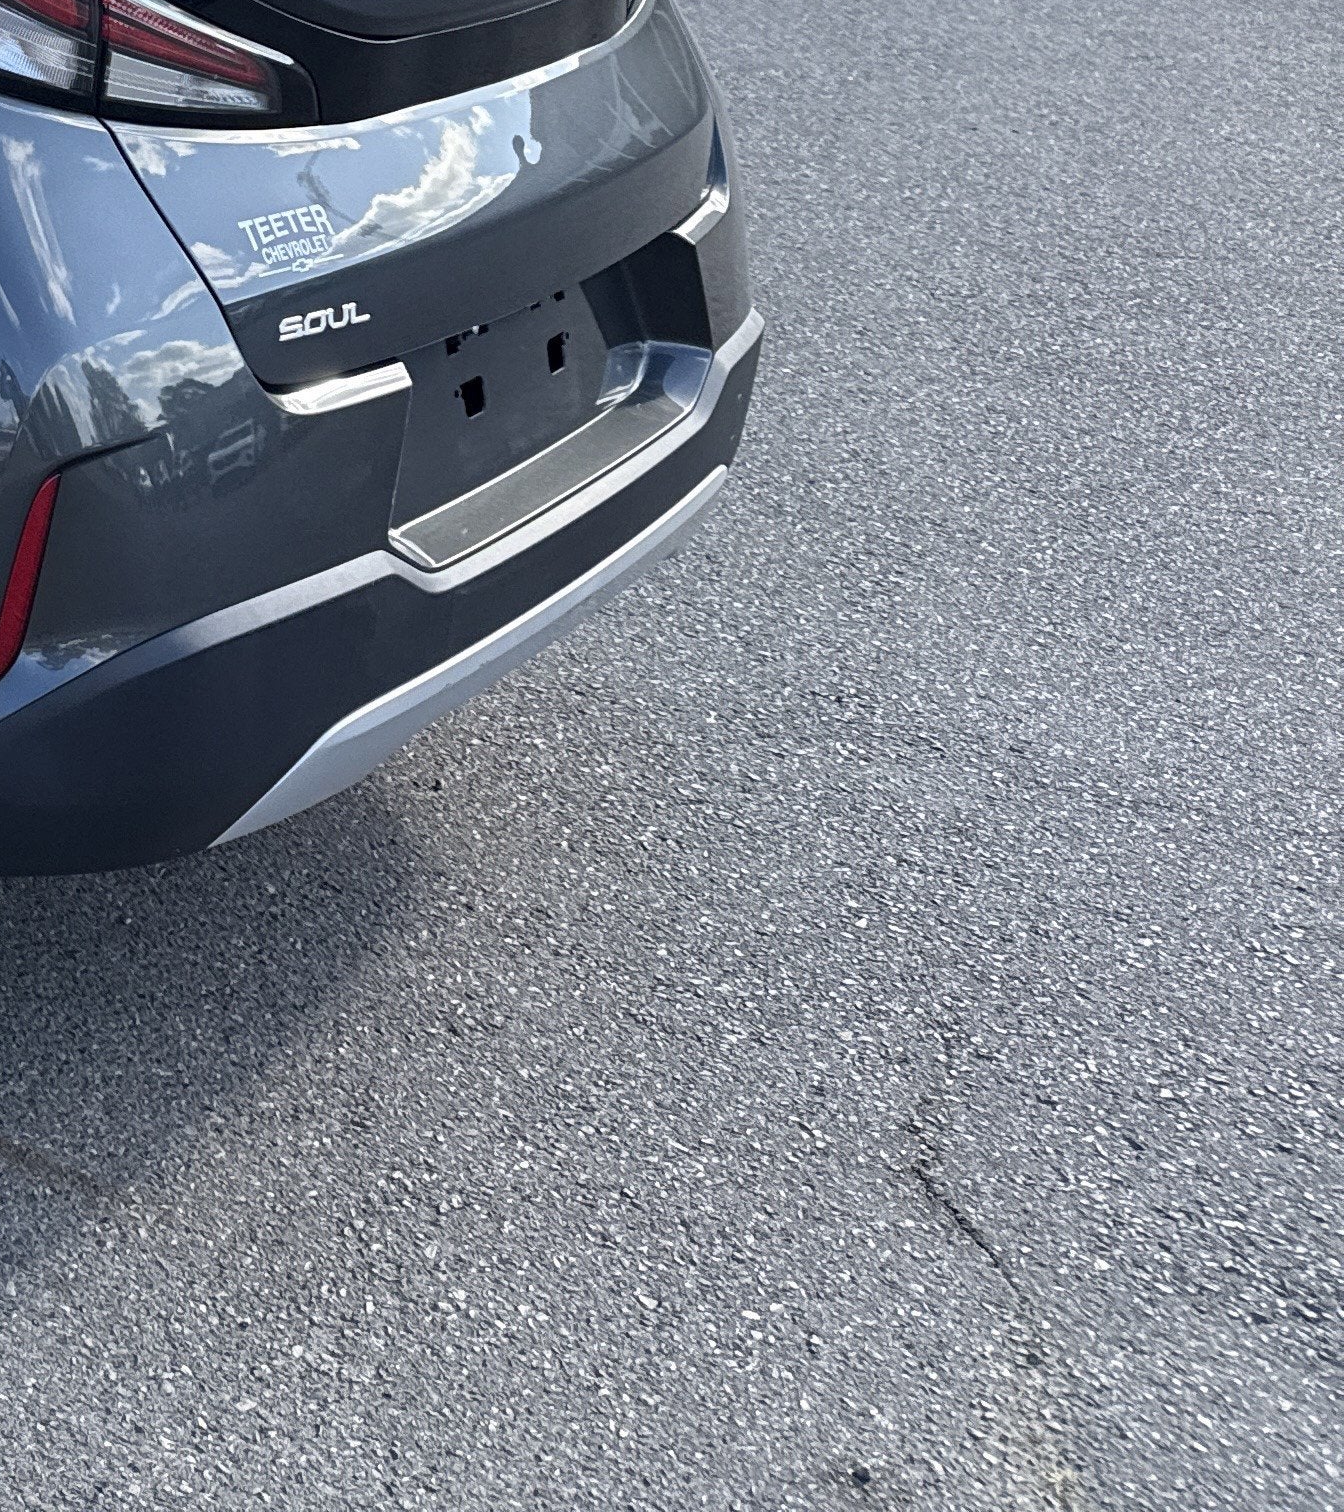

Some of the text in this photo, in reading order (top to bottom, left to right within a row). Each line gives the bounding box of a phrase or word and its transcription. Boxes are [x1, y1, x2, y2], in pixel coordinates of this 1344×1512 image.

[237, 203, 335, 251] TEETER
[262, 234, 329, 265] CHEVROLET
[278, 302, 371, 342] SOUL
